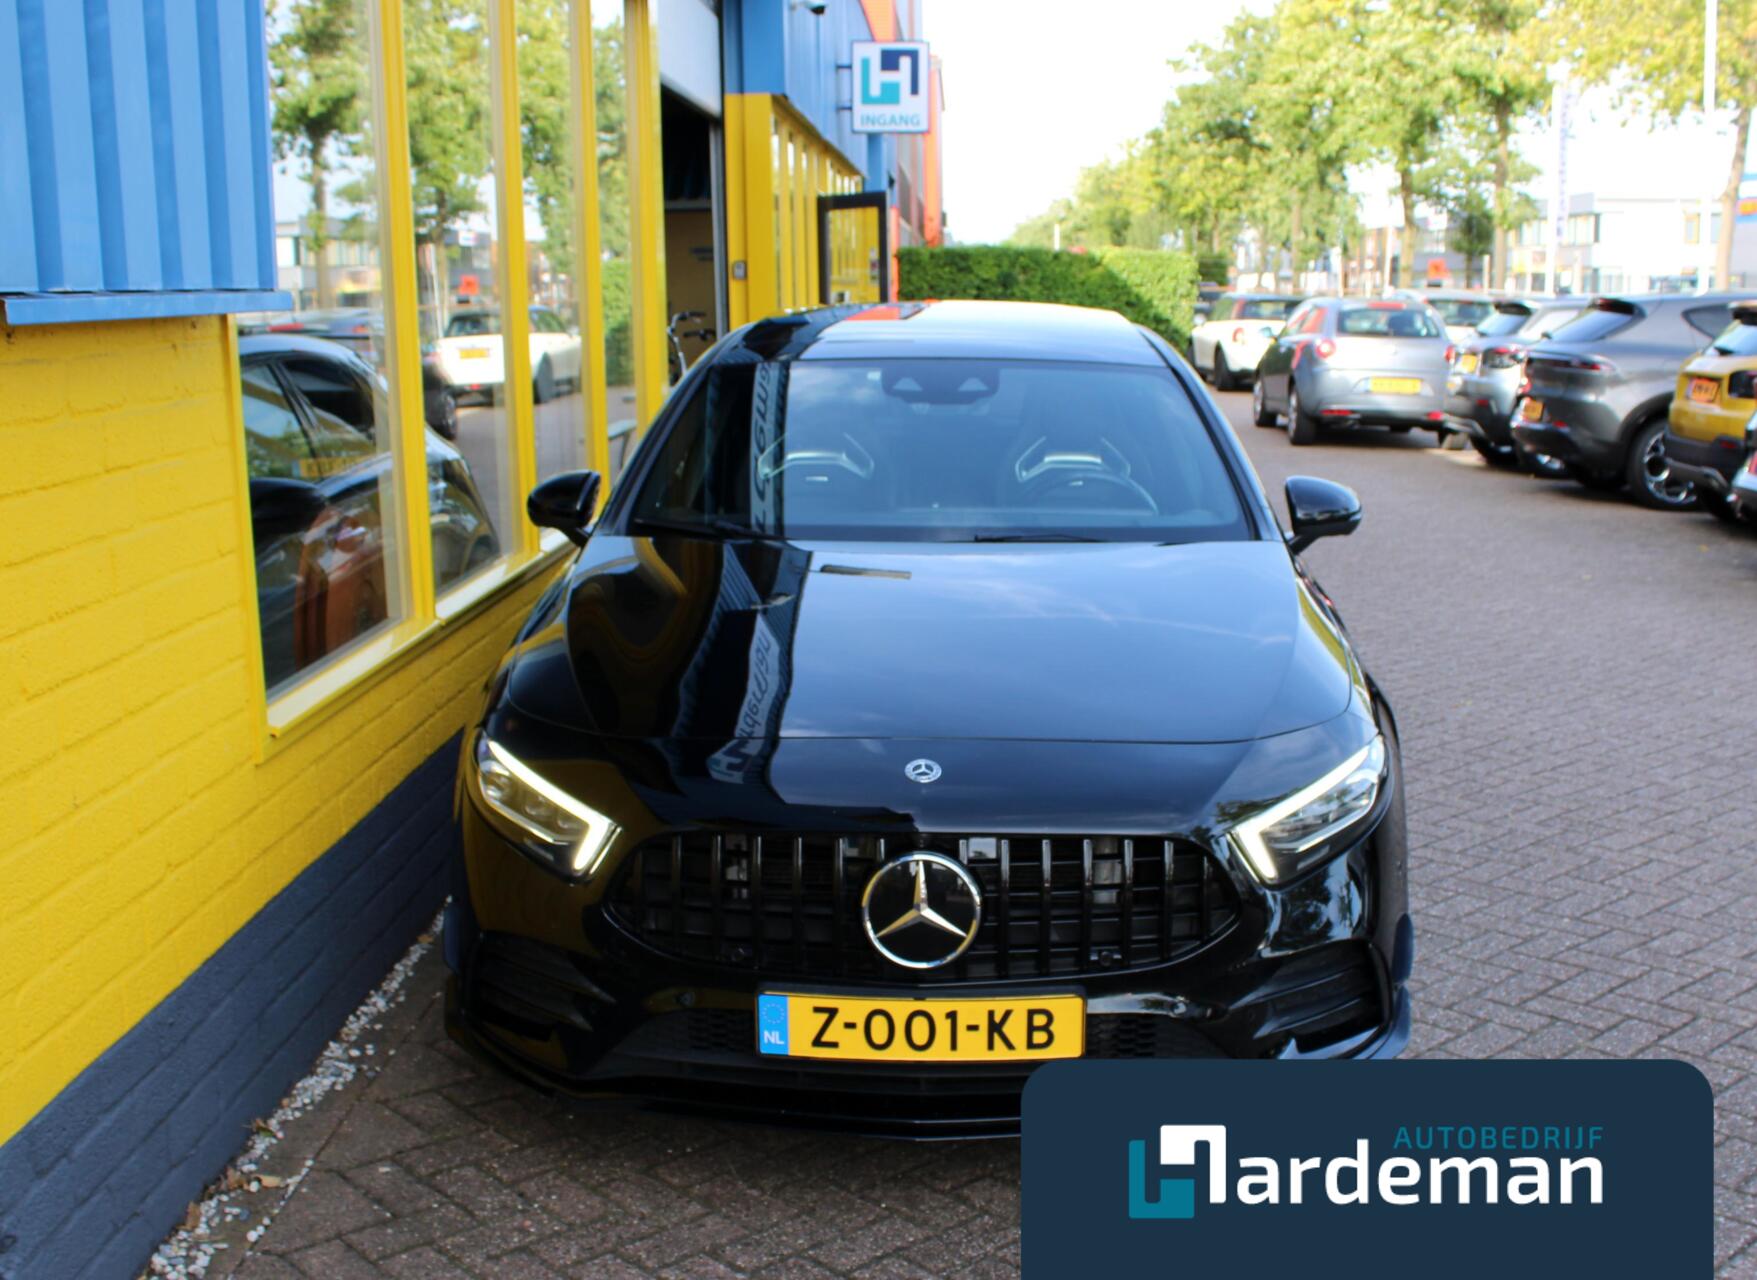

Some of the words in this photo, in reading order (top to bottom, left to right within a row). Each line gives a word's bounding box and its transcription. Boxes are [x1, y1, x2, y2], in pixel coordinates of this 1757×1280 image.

[860, 114, 920, 127] INGANG
[811, 1006, 1055, 1051] Z-001-KB
[763, 1030, 785, 1046] NL
